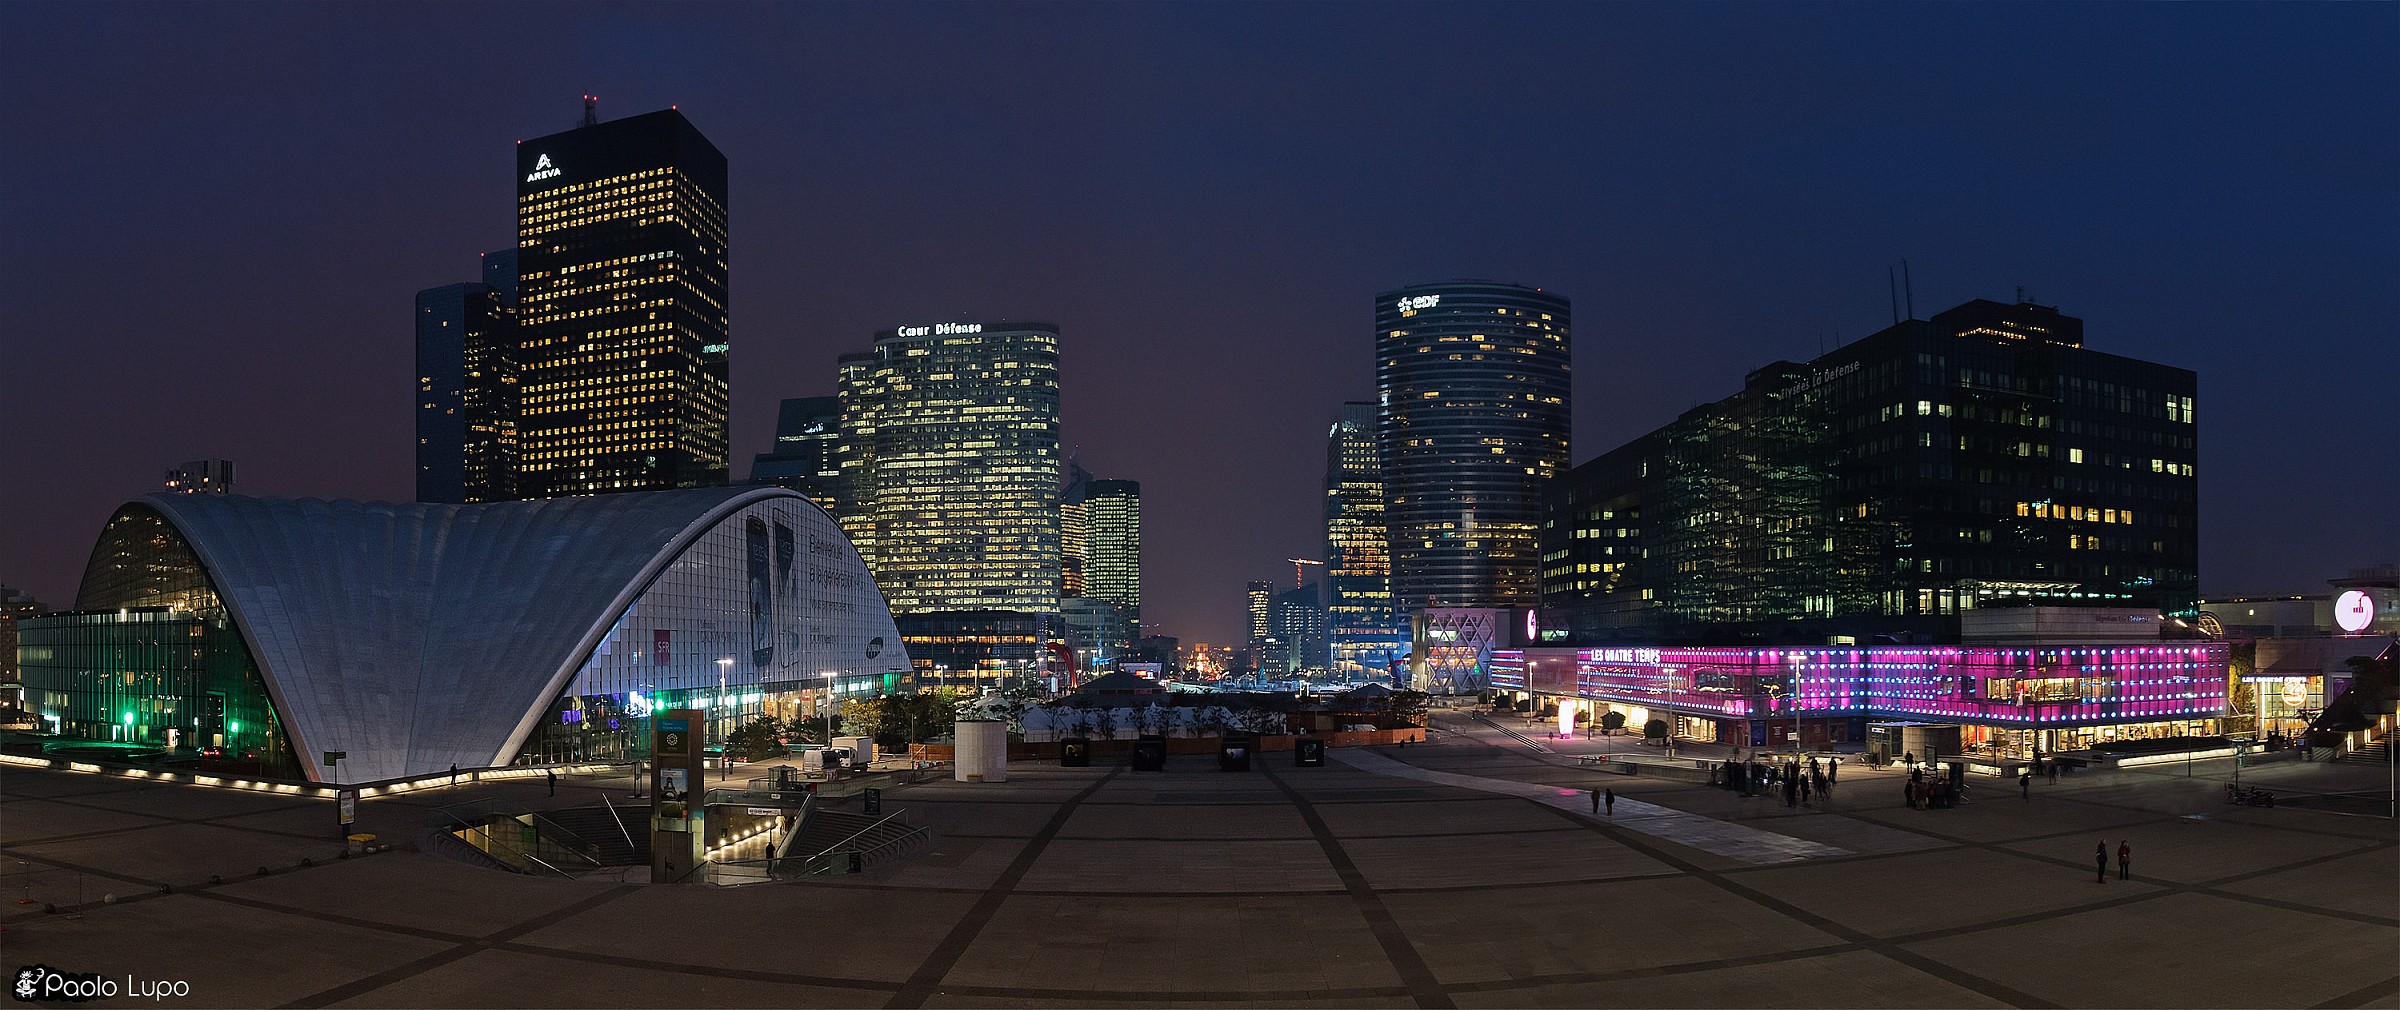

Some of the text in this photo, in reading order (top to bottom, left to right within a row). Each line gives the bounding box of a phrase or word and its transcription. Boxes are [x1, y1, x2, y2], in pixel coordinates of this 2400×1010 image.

[527, 168, 561, 182] AREVA
[935, 323, 982, 334] Défense
[658, 641, 670, 653] SFR
[1591, 649, 1660, 663] LES QUATRE TEMPS
